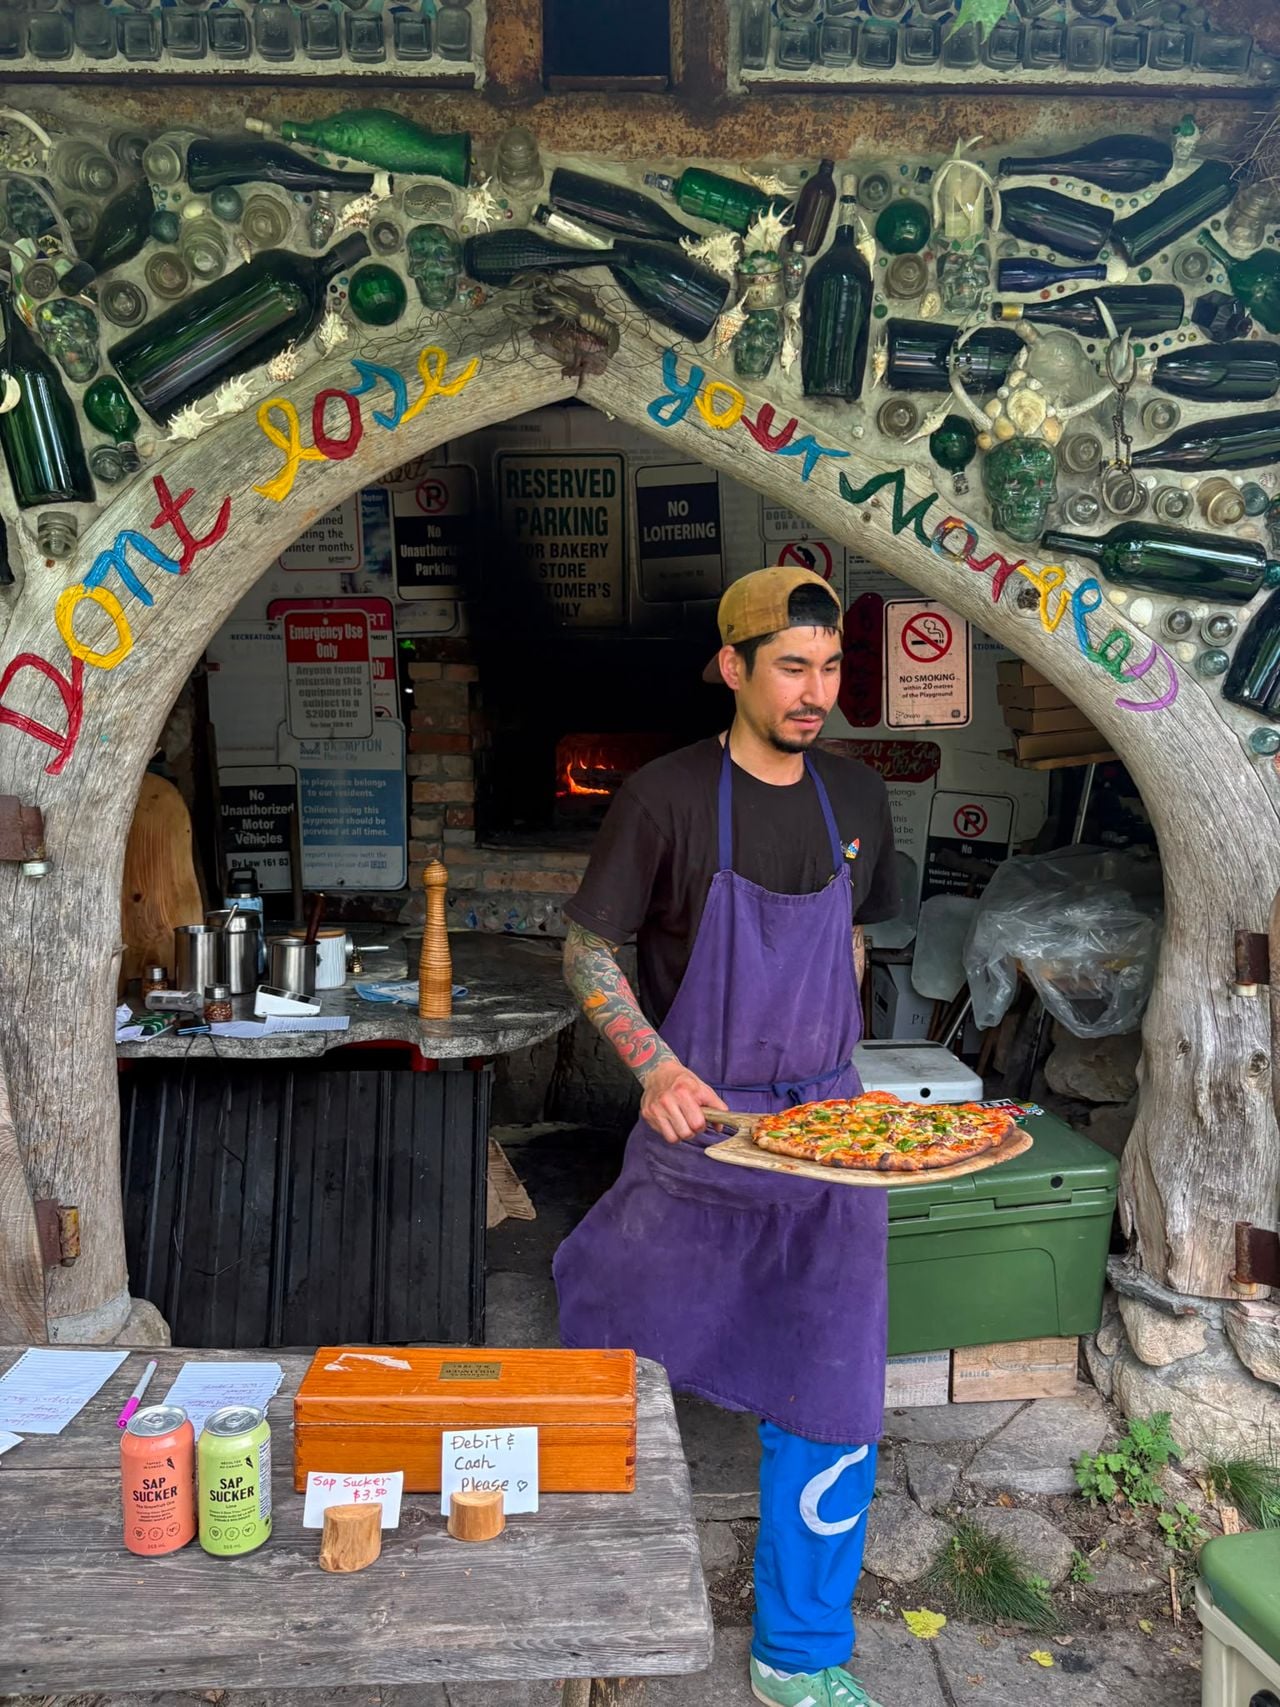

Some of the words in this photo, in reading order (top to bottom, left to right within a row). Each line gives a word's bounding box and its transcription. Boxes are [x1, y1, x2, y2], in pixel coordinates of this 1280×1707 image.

[505, 468, 616, 498] RESERVED
[667, 500, 690, 518] NO
[514, 506, 609, 536] PARKING
[328, 529, 344, 540] the
[426, 524, 441, 539] No
[643, 522, 717, 542] LOITERING
[319, 542, 354, 552] months
[526, 543, 545, 558] OR
[550, 543, 609, 558] BAKERY
[540, 563, 587, 578] STORE
[546, 583, 611, 598] TOMER'S
[231, 633, 282, 641] RECREATIONA
[289, 623, 343, 641] Emergency
[344, 623, 364, 640] Use
[316, 642, 339, 660] Only
[296, 666, 332, 675] Anyone
[334, 665, 362, 675] found
[296, 677, 341, 687] misusing
[343, 676, 362, 685] this
[899, 675, 913, 684] NO
[914, 673, 955, 683] SMOKING
[298, 688, 351, 698] equipment
[353, 687, 363, 696] is
[302, 699, 340, 708] subject
[341, 699, 351, 707] to
[305, 709, 337, 718] $2000
[338, 709, 358, 718] fine
[323, 739, 382, 753] BRMPTON
[354, 777, 387, 788] belongs
[248, 788, 265, 801] No
[307, 789, 318, 797] to
[887, 788, 916, 797] elongs
[221, 802, 295, 817] Unauthorized
[303, 805, 338, 814] Children
[364, 805, 379, 814] this
[242, 818, 275, 831] Motor
[375, 816, 386, 825] be
[234, 831, 284, 846] Vehicles
[351, 827, 362, 836] all
[961, 844, 973, 855] No
[232, 858, 242, 868] By
[243, 857, 260, 867] Law
[450, 1433, 501, 1451] Debit
[454, 1454, 496, 1470] Cash
[143, 1477, 166, 1490] SAP
[220, 1476, 244, 1490] SAP
[312, 1475, 337, 1490] Sap
[343, 1475, 392, 1488] Sucker
[461, 1476, 509, 1493] Please
[133, 1486, 178, 1502] SUCKER
[210, 1486, 255, 1502] SUCKER
[353, 1488, 388, 1503] $3.50
